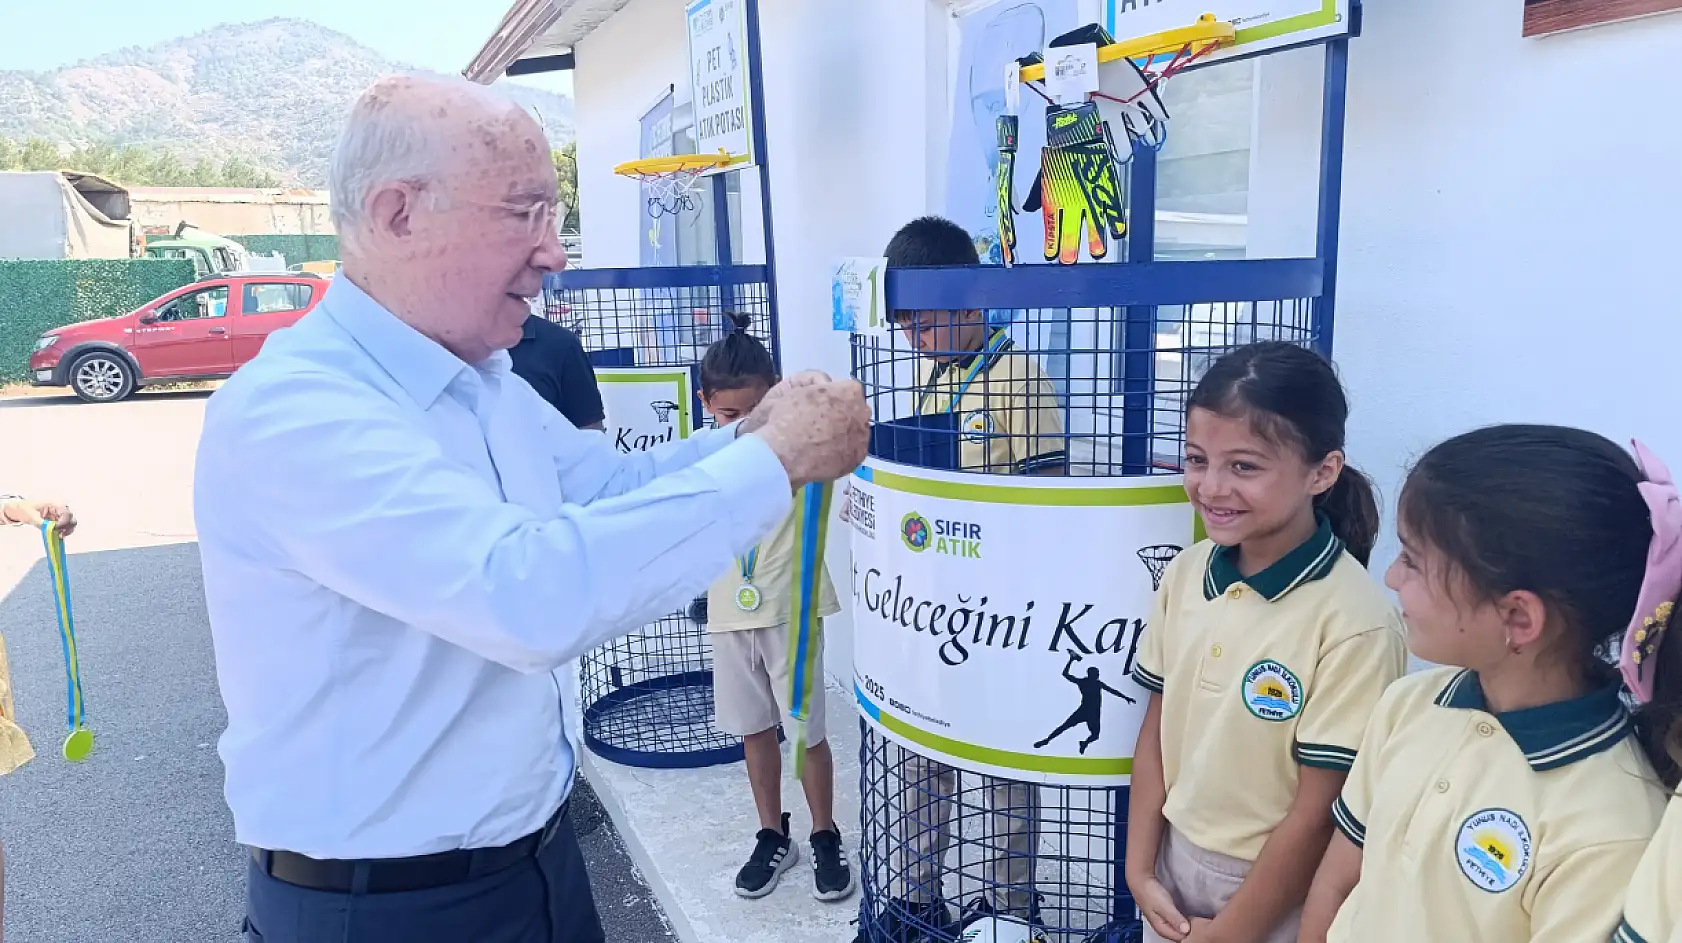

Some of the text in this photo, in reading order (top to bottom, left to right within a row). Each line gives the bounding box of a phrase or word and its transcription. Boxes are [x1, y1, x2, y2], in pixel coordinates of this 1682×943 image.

[707, 45, 721, 73] PET
[1048, 212, 1056, 250] KIPSTA
[935, 519, 982, 540] SIFIR
[935, 537, 982, 559] ATIK
[864, 567, 1036, 666] Geleceğini
[865, 674, 885, 701] 2025
[1466, 813, 1496, 831] YUNUS
